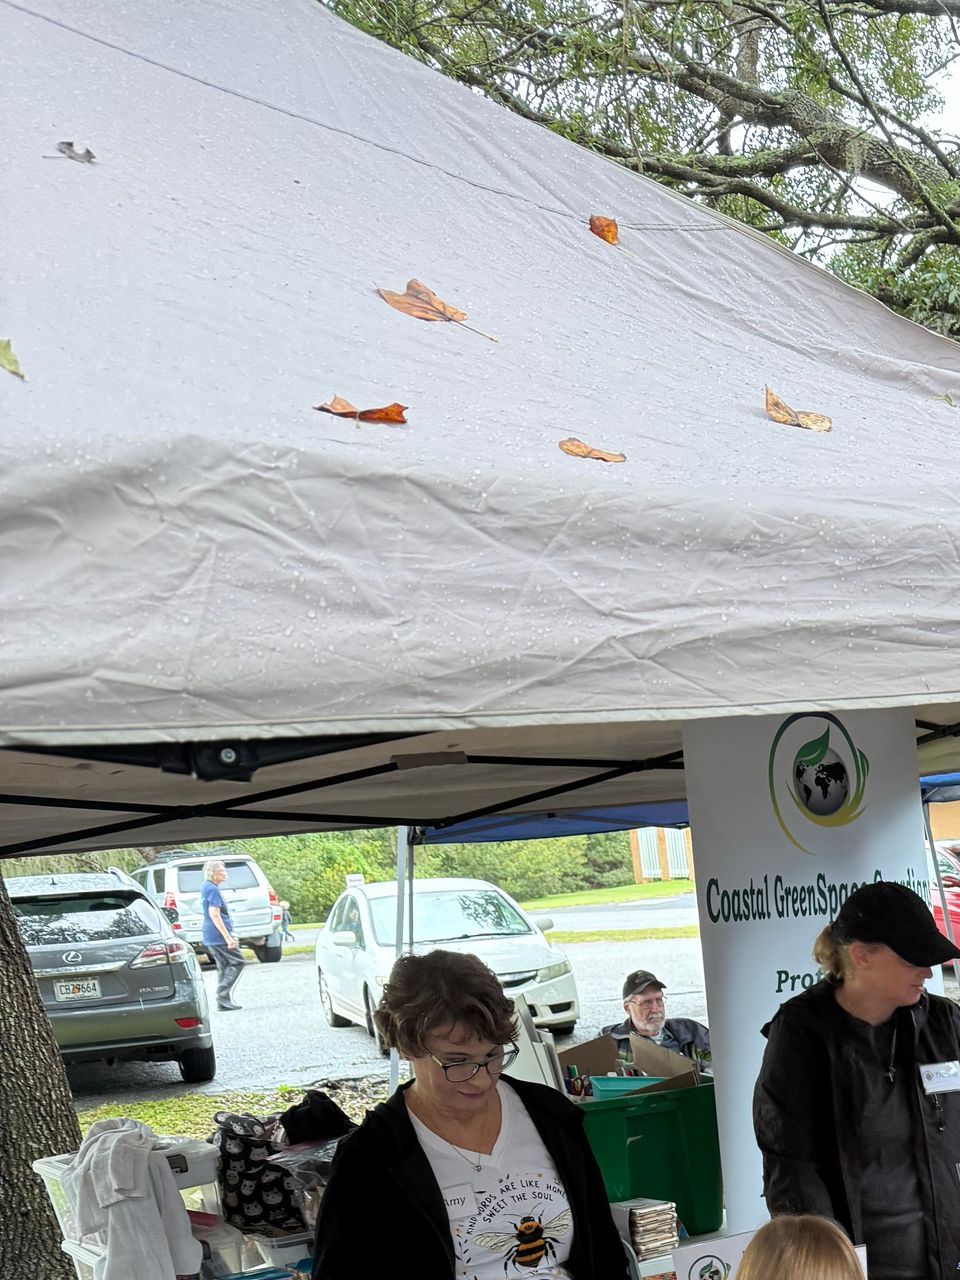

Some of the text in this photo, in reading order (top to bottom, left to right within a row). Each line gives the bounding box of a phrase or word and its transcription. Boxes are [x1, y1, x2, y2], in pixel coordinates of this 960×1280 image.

[706, 874, 771, 923] Coastal
[774, 872, 866, 923] GreenSpa
[775, 967, 822, 993] Prot
[466, 1216, 478, 1236] KIND
[500, 1182, 517, 1195] ARE
[520, 1180, 539, 1189] LIKE
[546, 1184, 567, 1199] HONE
[482, 1191, 553, 1223] SWEET THE SOUL
